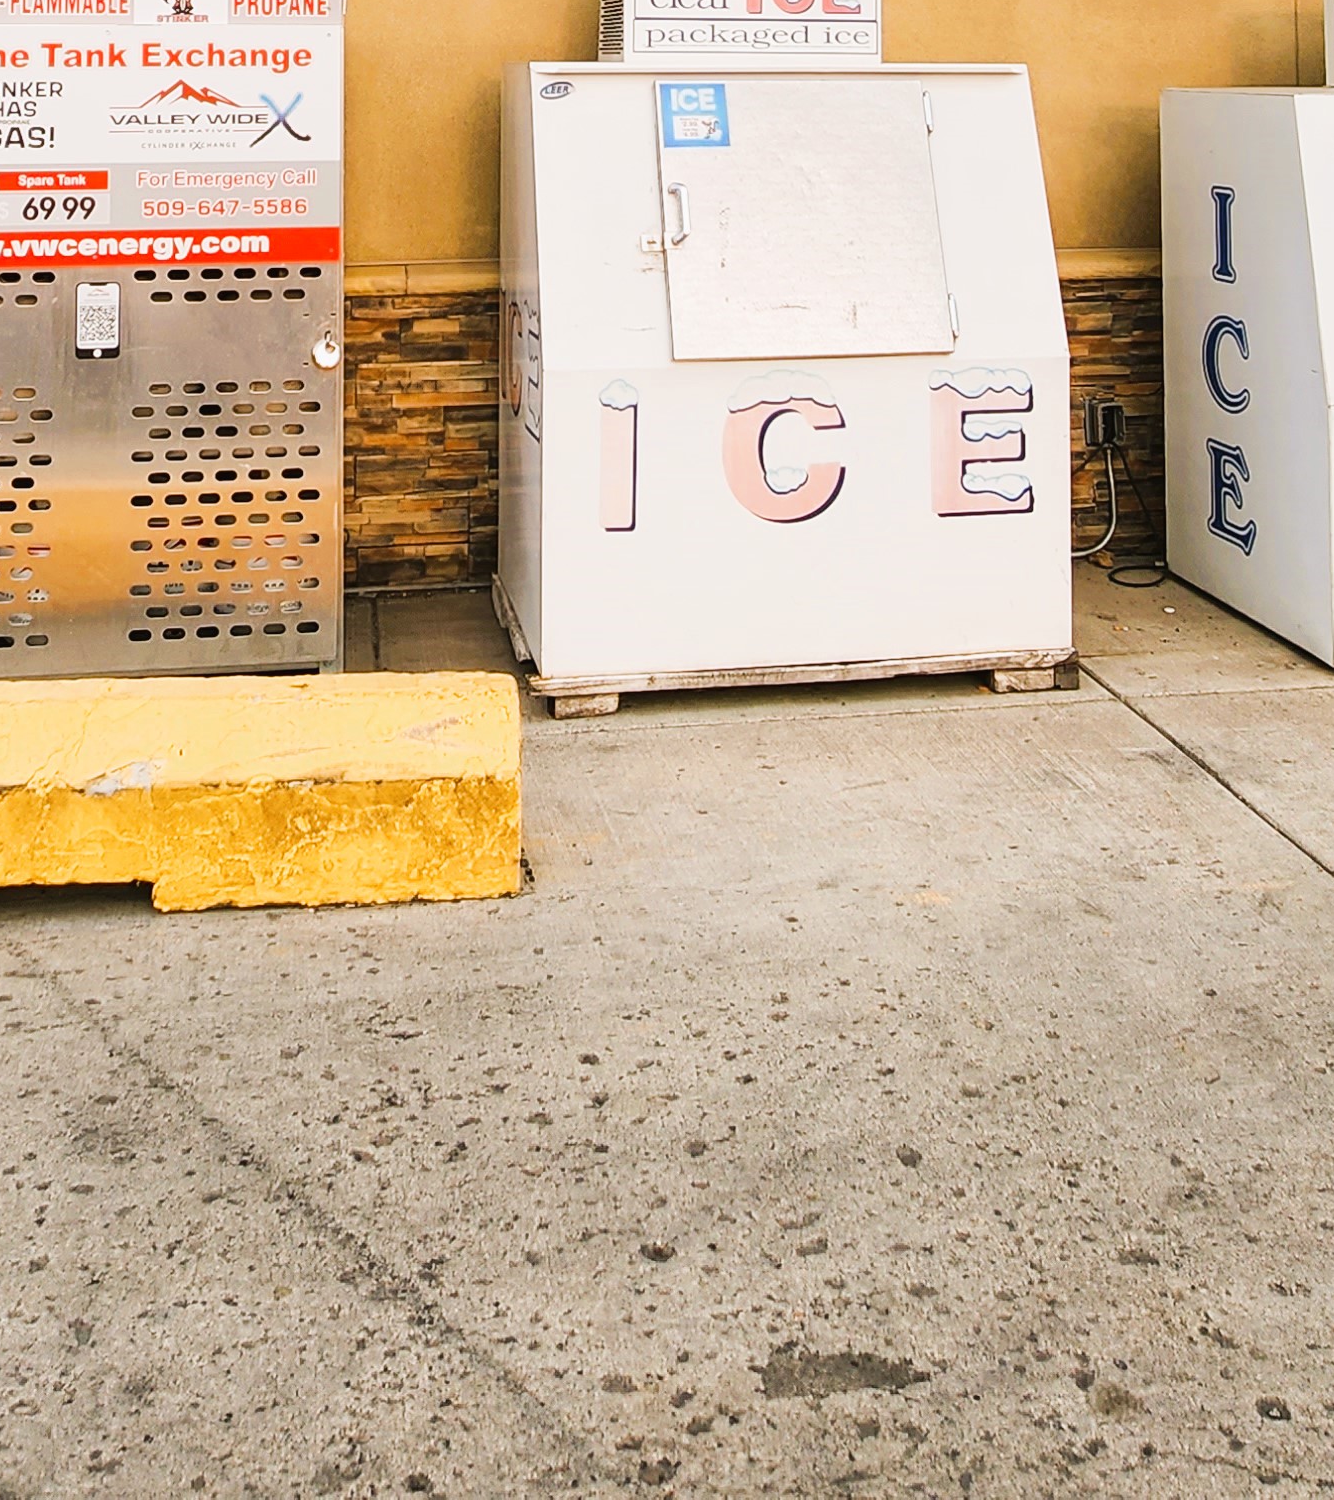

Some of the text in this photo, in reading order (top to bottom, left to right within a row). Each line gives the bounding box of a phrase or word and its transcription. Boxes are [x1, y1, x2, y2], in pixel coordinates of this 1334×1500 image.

[156, 14, 210, 23] STINKER
[645, 24, 870, 49] packaged ice
[41, 43, 127, 68] Tank
[142, 42, 312, 74] Exchange
[670, 88, 717, 112] ICE
[109, 113, 201, 126] VALLEY
[206, 113, 269, 125] WIDE
[188, 141, 237, 150] EXCHANGE
[18, 173, 87, 189] Spare Tank
[137, 169, 317, 189] For Emergency Call
[142, 198, 308, 217] 509-647-5586
[1200, 185, 1257, 557] ICE
[599, 367, 1034, 532] ICE
